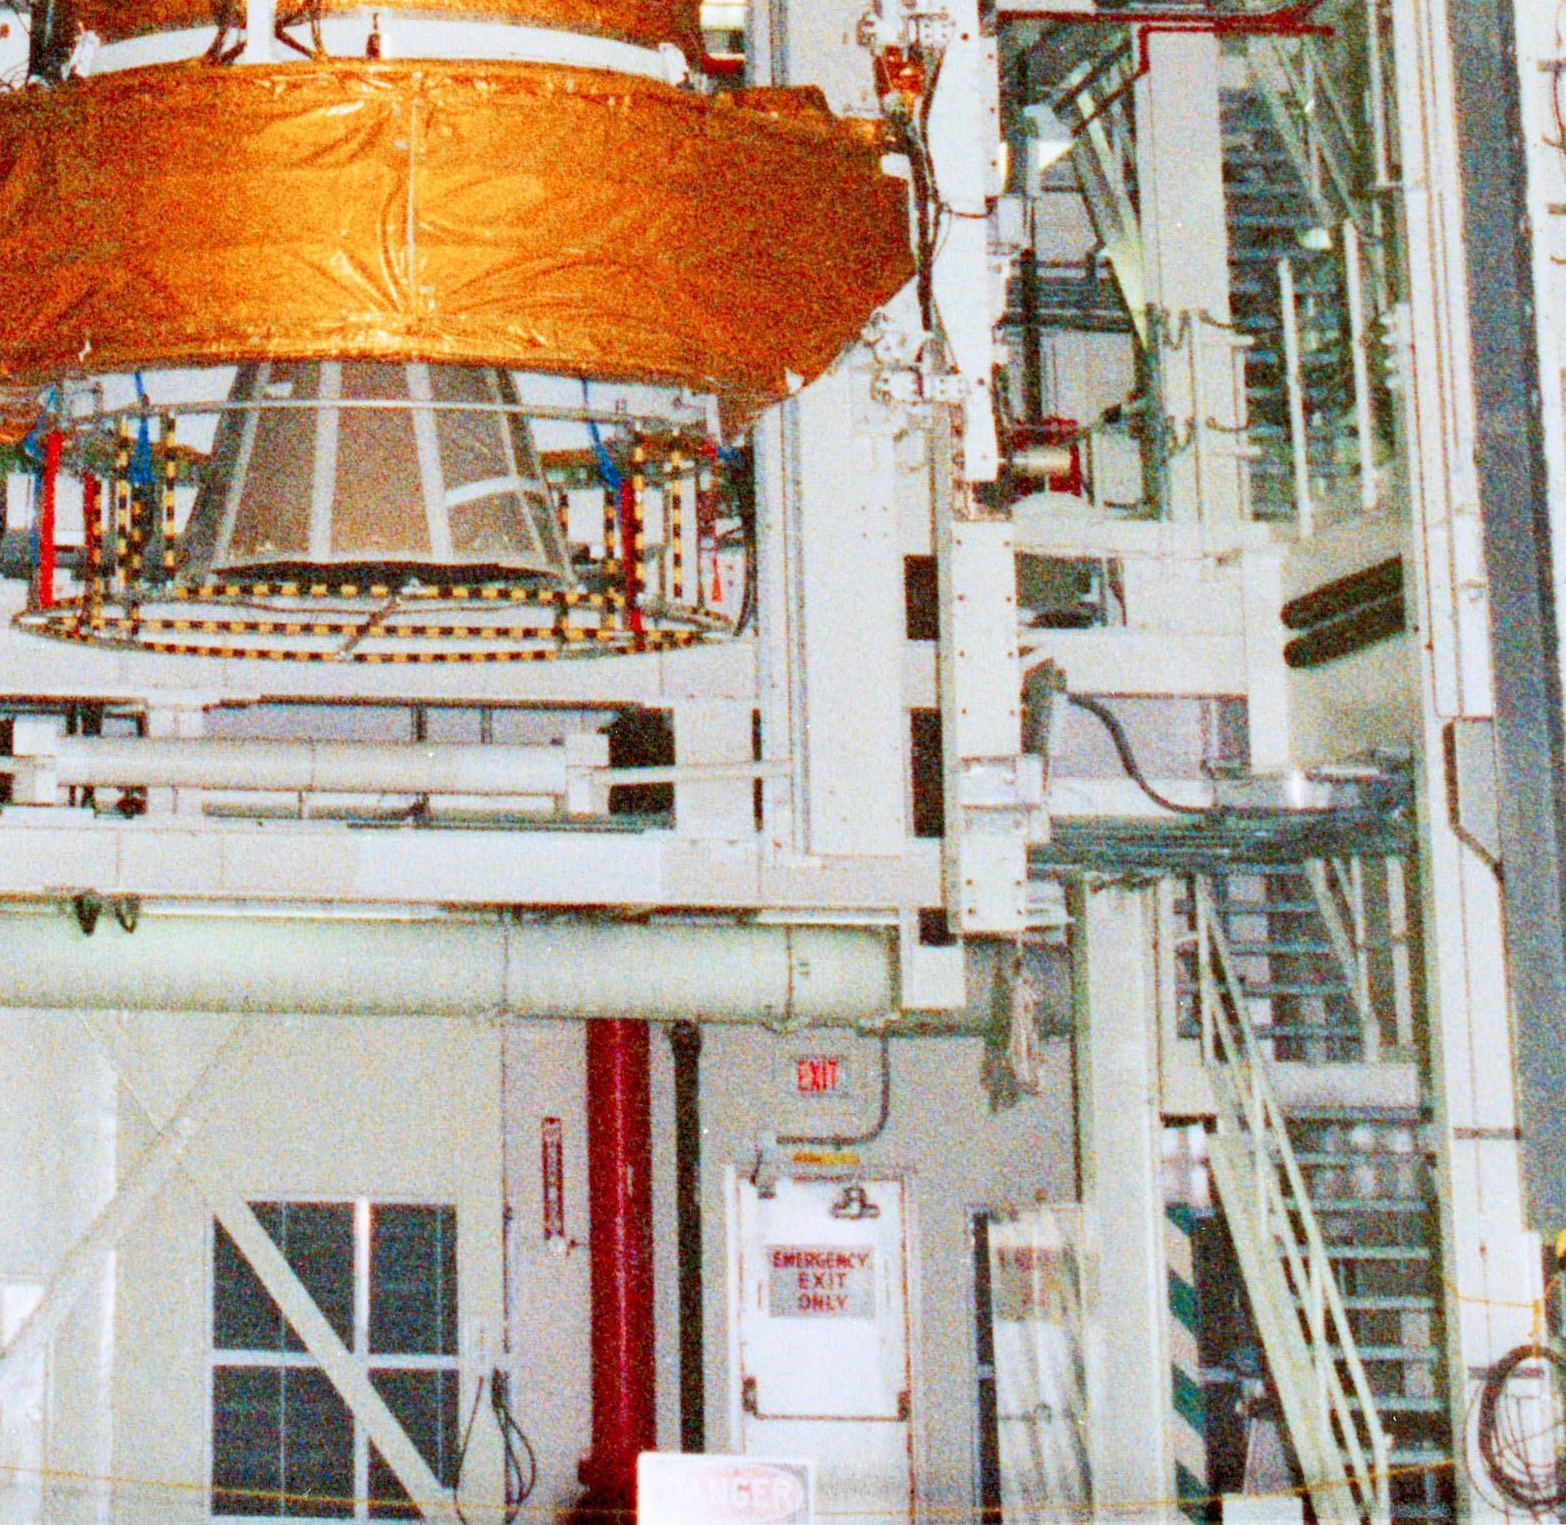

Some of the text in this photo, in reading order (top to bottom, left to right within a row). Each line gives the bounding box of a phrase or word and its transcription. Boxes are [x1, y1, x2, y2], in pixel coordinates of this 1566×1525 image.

[797, 1059, 839, 1092] EXIT
[773, 1251, 868, 1268] EMERGENCY
[798, 1271, 847, 1290] EXIT
[798, 1293, 848, 1311] ONLY
